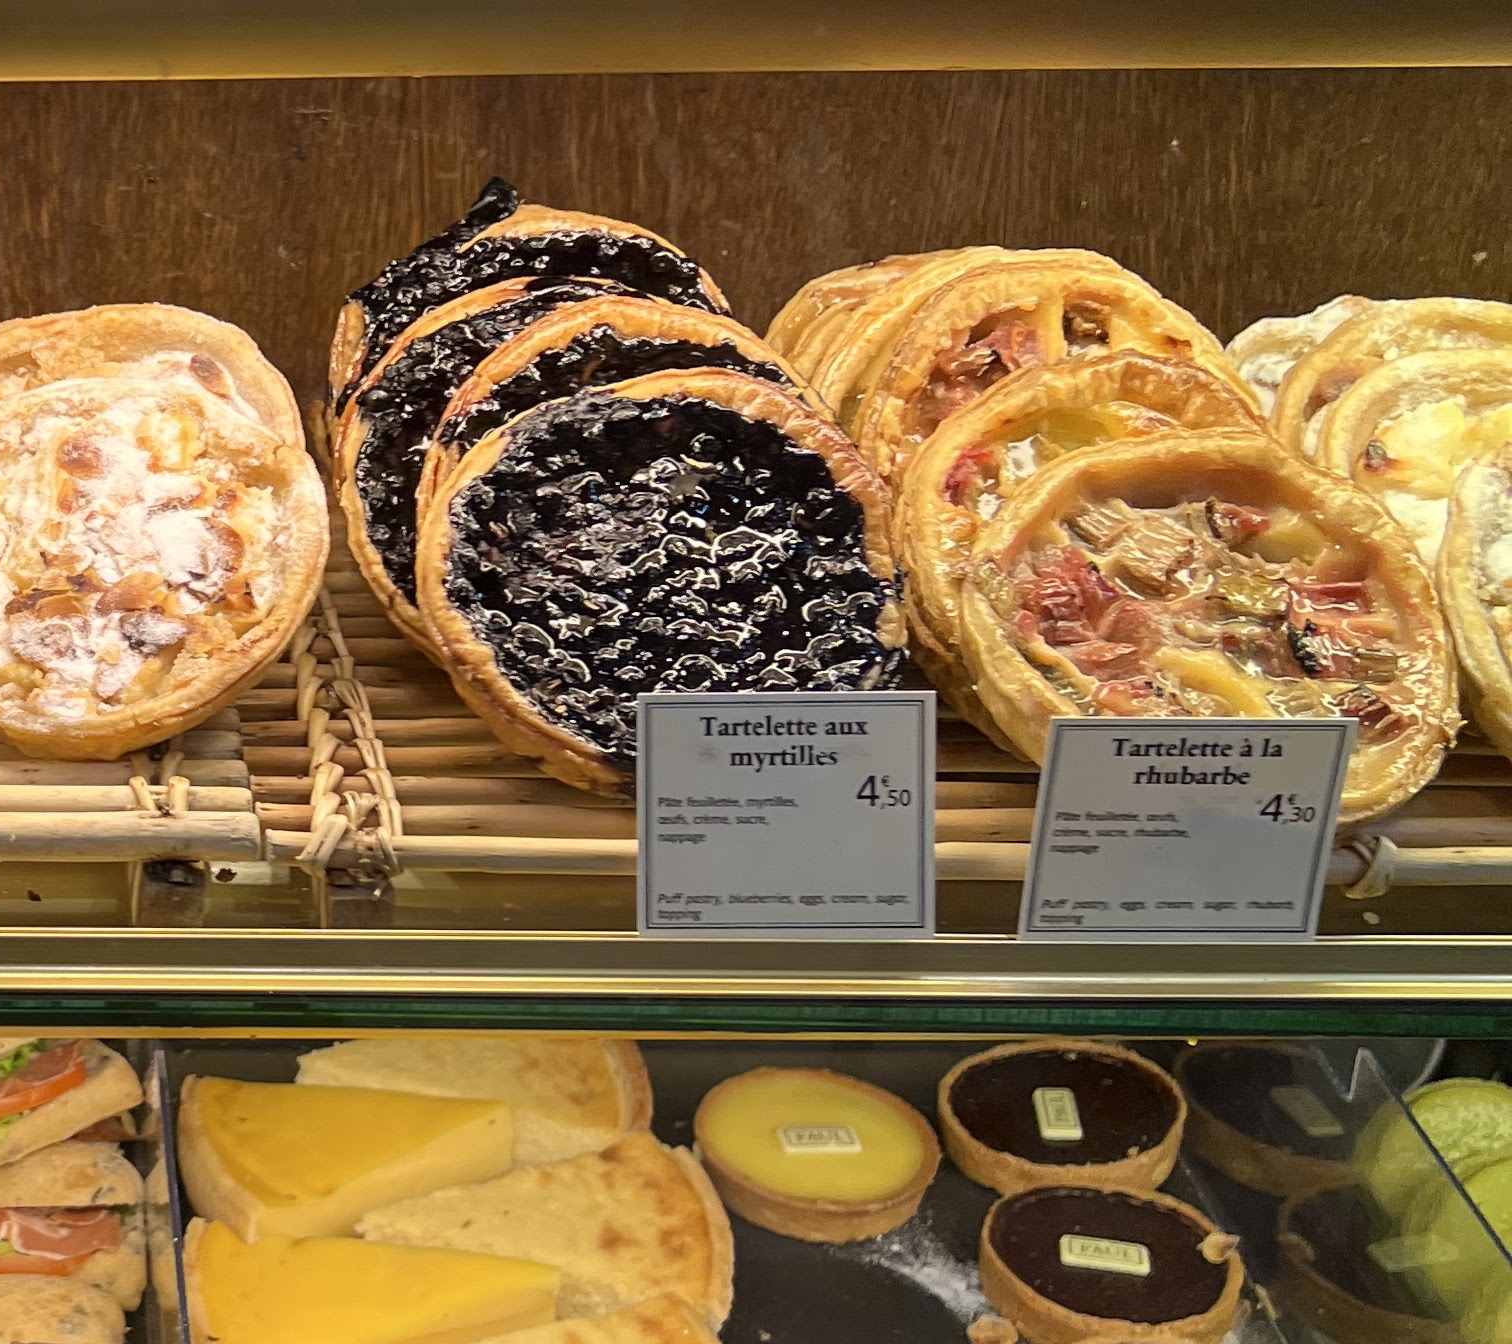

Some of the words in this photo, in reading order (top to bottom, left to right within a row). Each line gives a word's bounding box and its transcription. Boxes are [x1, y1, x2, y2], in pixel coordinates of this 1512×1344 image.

[700, 715, 818, 736] Tartelette
[825, 722, 868, 735] aux
[1113, 738, 1233, 757] Tartelette
[1239, 738, 1253, 757] à
[1261, 738, 1282, 757] la
[730, 745, 838, 773] myrtilles
[1133, 766, 1251, 785] rhubarbe
